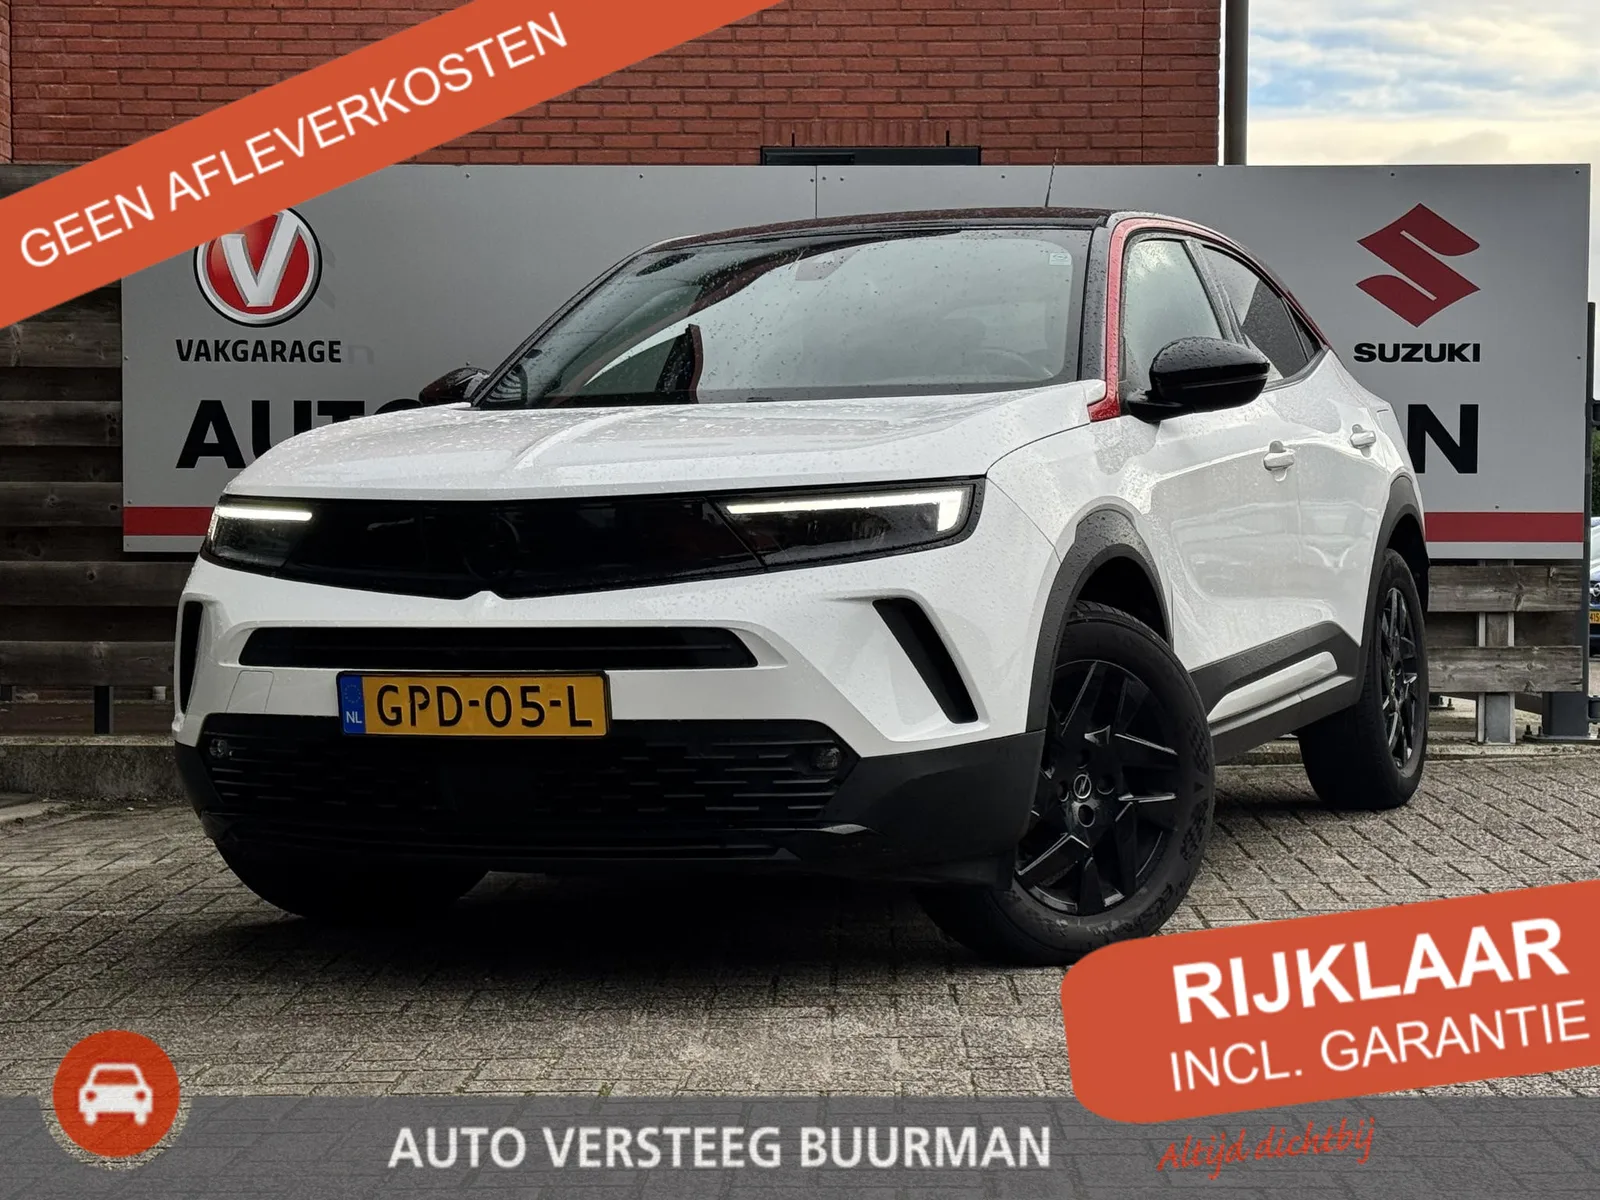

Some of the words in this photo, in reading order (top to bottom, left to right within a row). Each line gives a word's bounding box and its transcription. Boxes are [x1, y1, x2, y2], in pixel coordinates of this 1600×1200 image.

[175, 339, 342, 363] VAKGARAGE
[1353, 342, 1481, 363] SUZUKI
[345, 711, 363, 724] NL
[376, 684, 593, 728] GPD-05-L
